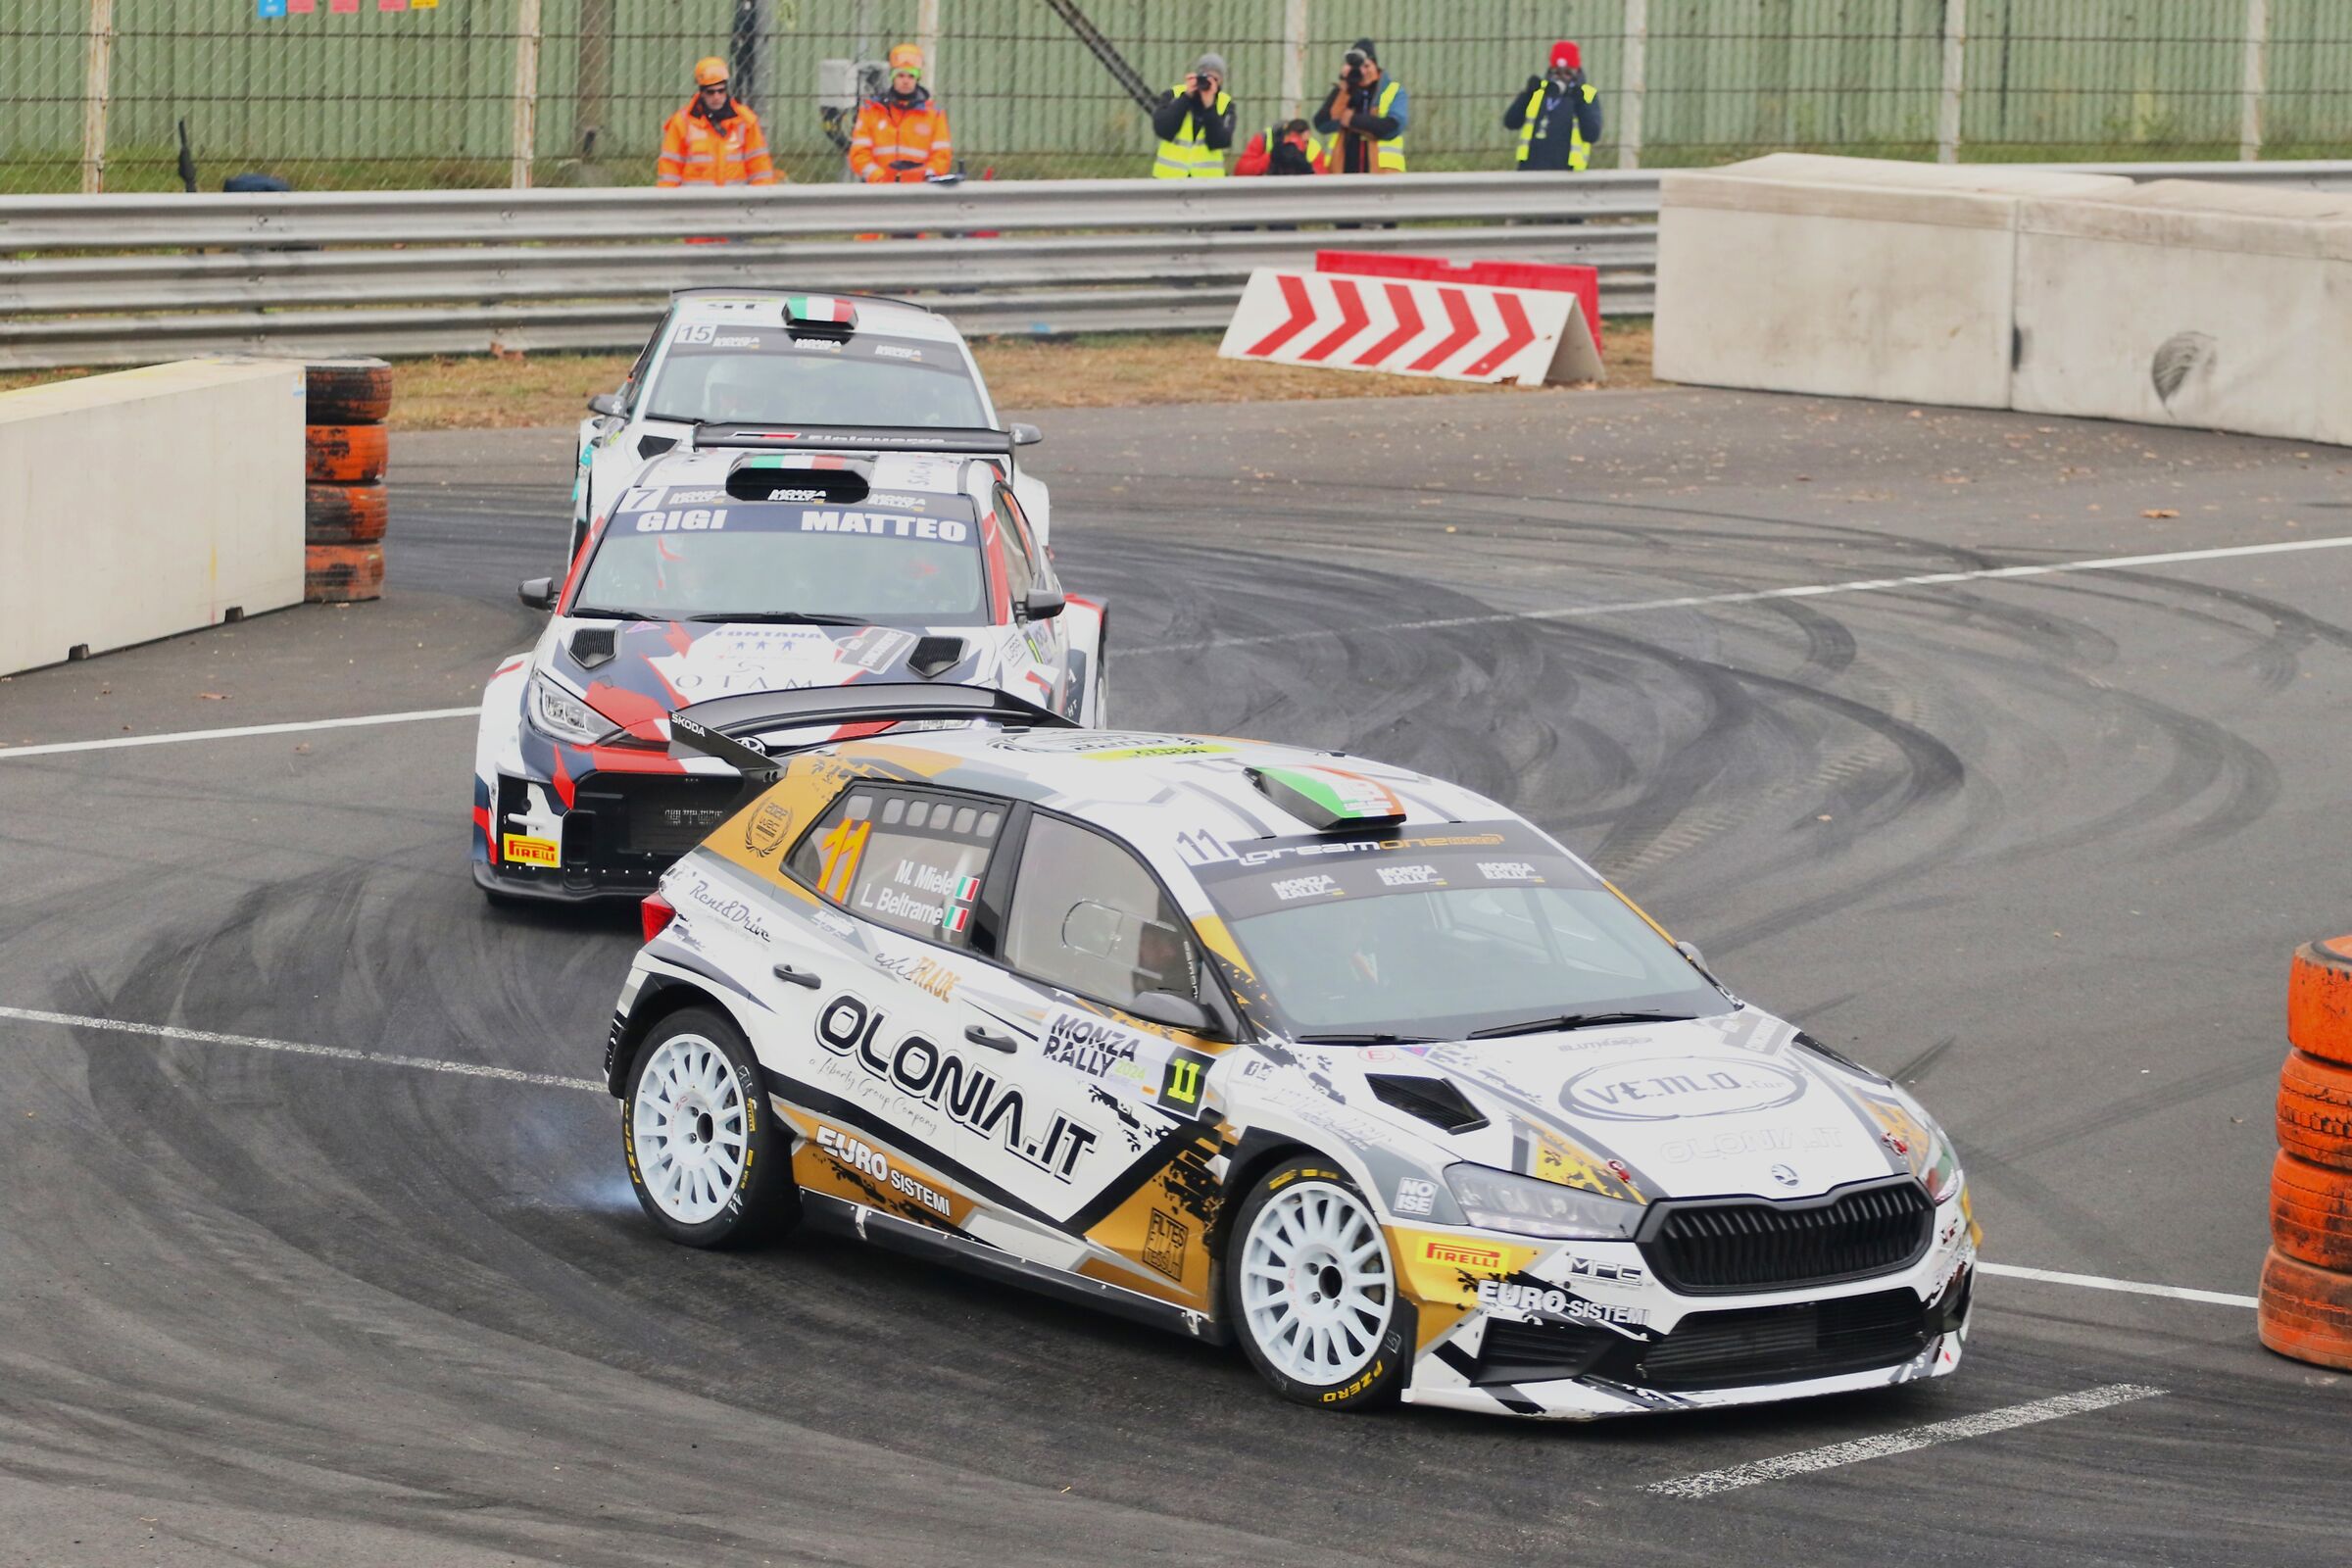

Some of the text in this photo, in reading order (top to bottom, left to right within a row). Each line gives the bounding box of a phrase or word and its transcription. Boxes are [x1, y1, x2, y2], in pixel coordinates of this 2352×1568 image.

[681, 325, 711, 343] 15
[632, 489, 659, 509] 7
[636, 509, 728, 532] GIGI
[801, 510, 967, 542] MATTEO
[508, 839, 556, 863] PIRELLI
[1176, 828, 1229, 861] 11
[815, 816, 872, 906] 11
[894, 859, 955, 897] M. Miele
[1271, 874, 1336, 890] MONZA
[859, 882, 878, 910] L.
[876, 891, 944, 927] Beltrame
[1051, 1012, 1141, 1063] MONZA
[1042, 1034, 1118, 1079] RALLY
[1166, 1057, 1201, 1104] 11
[815, 1124, 889, 1182] EURO
[889, 1167, 952, 1217] SISTEMI
[1396, 1194, 1431, 1214] ISE
[1400, 1178, 1436, 1198] NO
[1426, 1242, 1501, 1269] PIRELLI
[1477, 1278, 1568, 1314] EURO
[1567, 1298, 1651, 1326] SISTEMI
